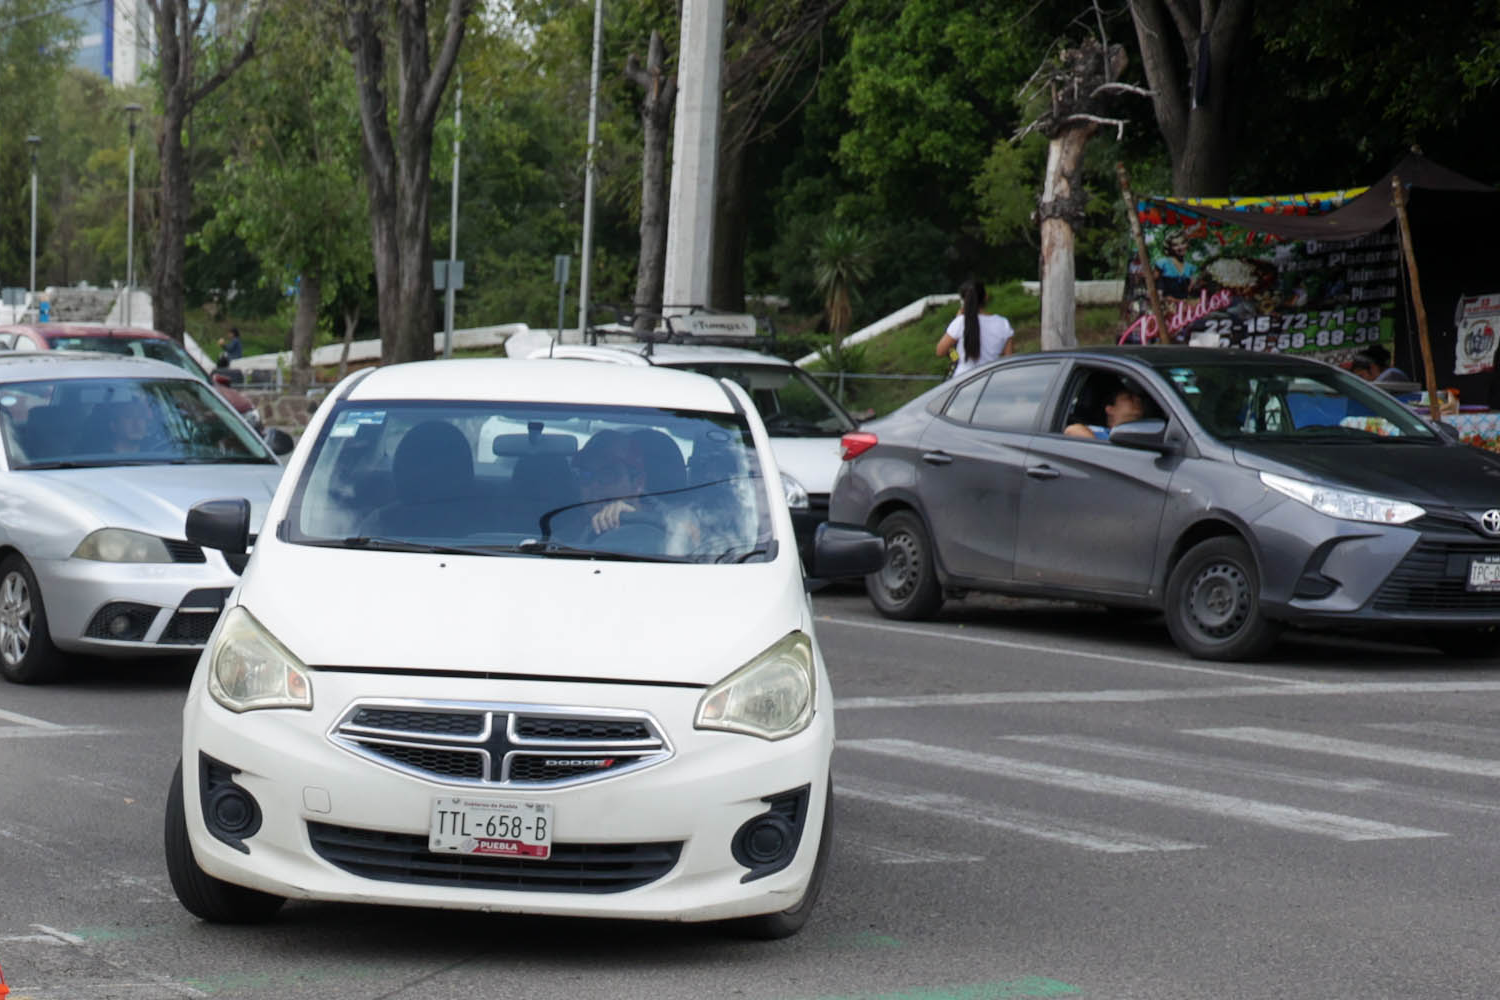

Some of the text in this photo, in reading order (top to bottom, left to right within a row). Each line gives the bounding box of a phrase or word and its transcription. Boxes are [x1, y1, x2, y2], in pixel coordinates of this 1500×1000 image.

[1219, 326, 1380, 350] 2-15-58-88-36
[438, 810, 547, 841] TTL-658-B
[480, 841, 518, 851] PUEBLA
